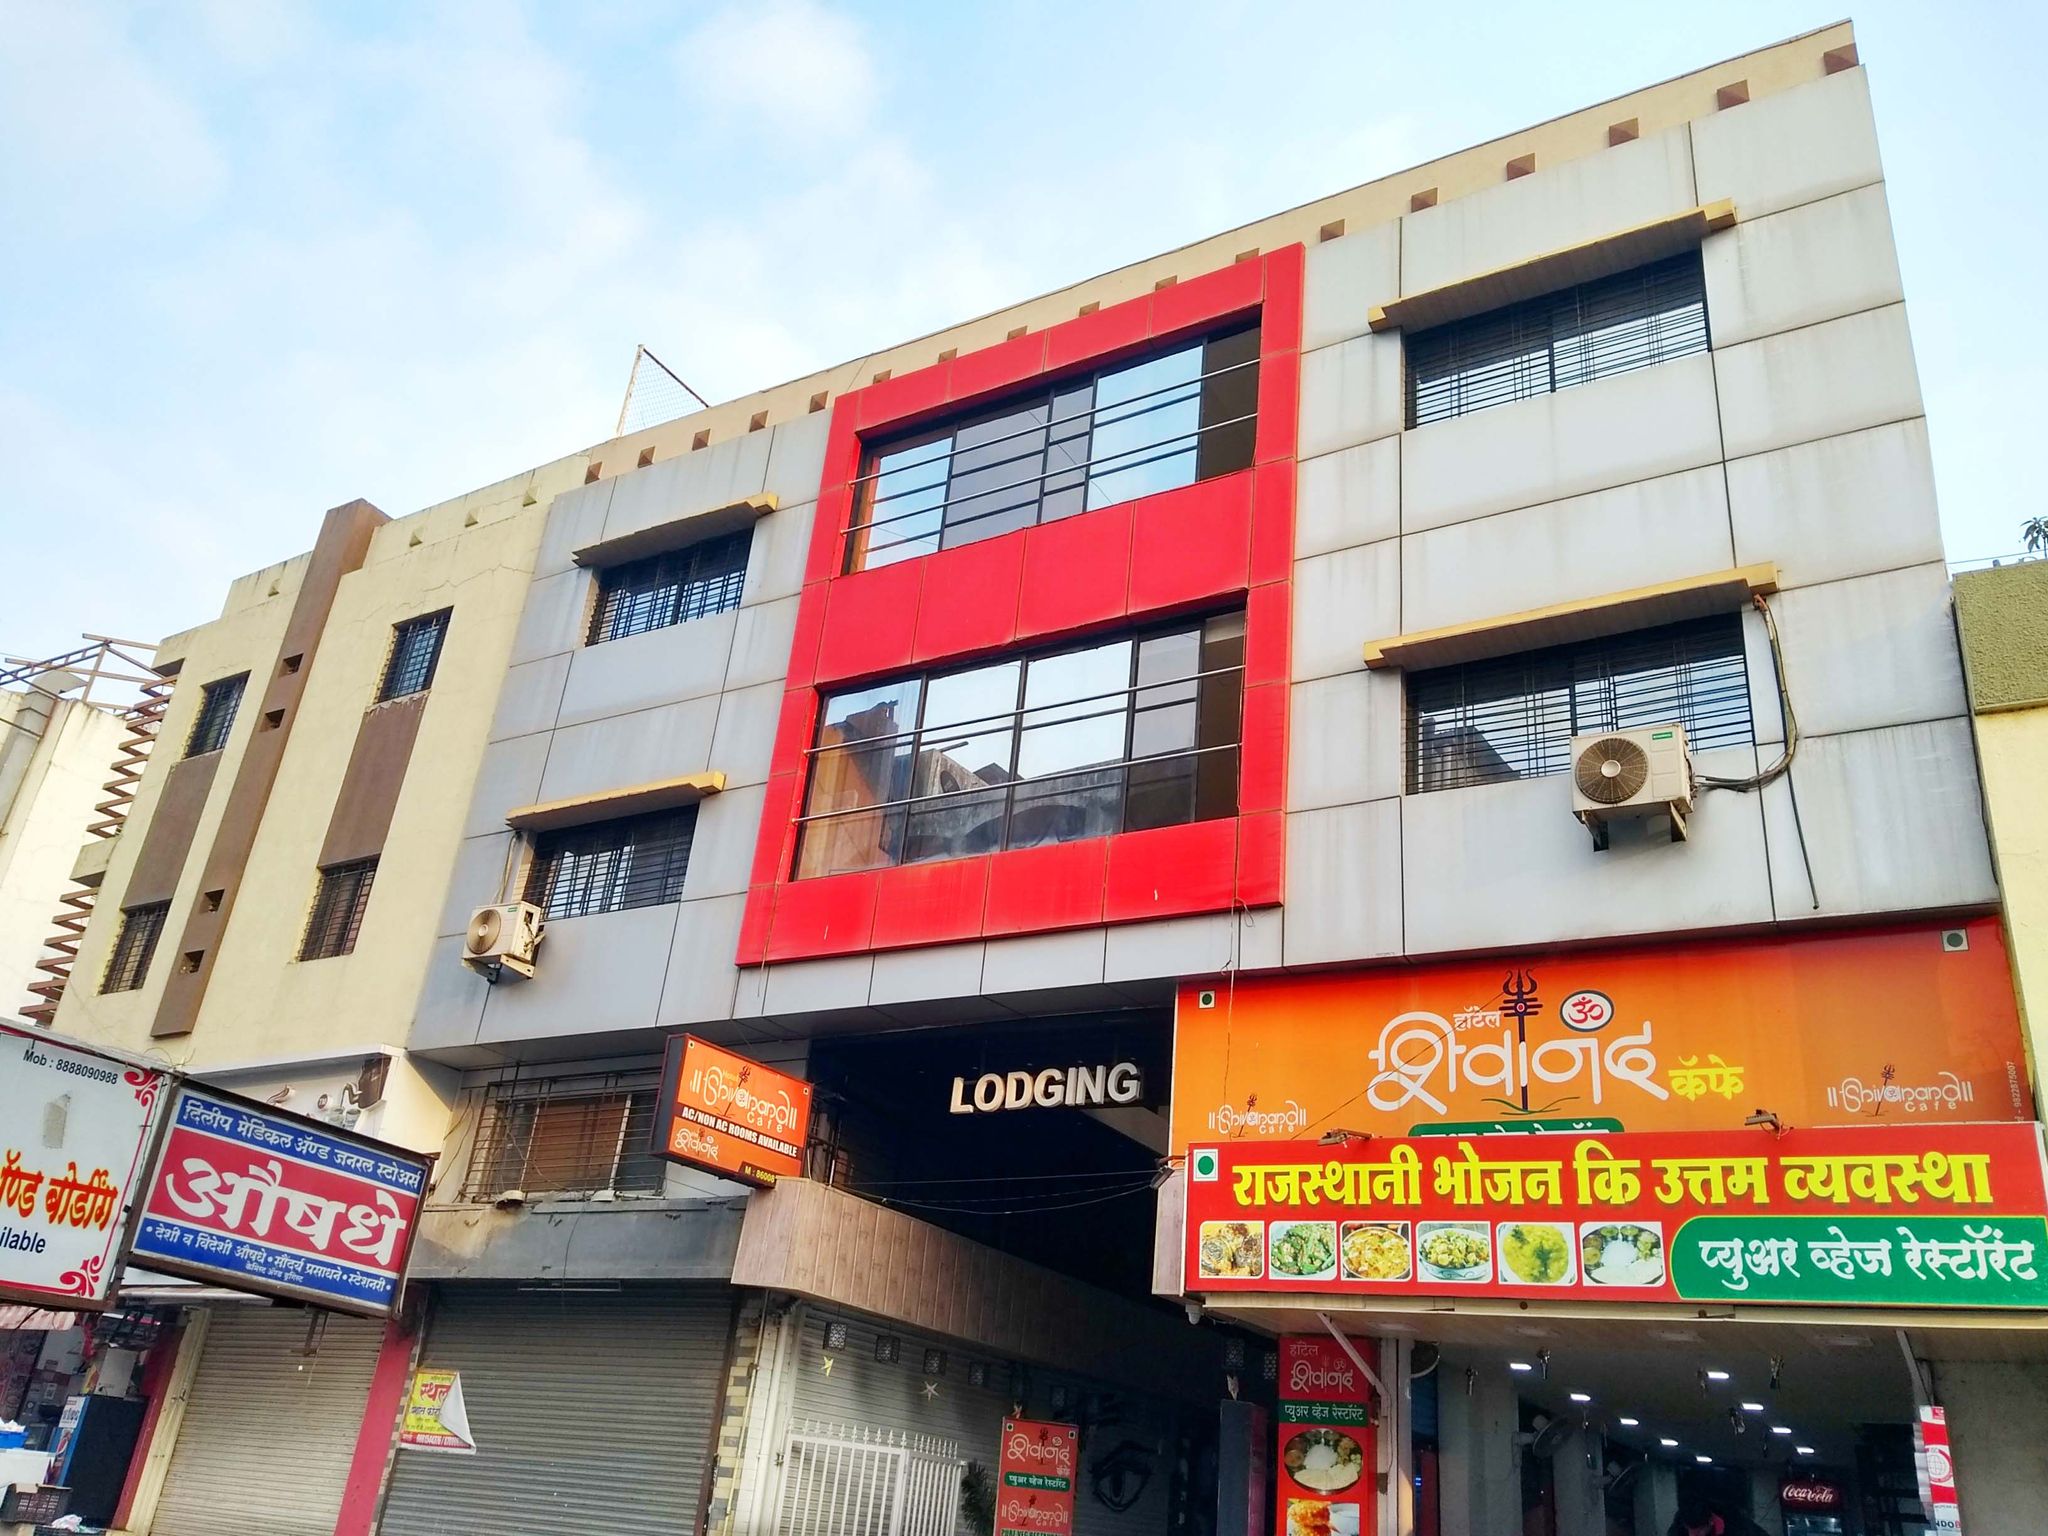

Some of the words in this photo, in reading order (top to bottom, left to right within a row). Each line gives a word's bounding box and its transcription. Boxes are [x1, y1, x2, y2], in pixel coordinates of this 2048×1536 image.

[1452, 1006, 1502, 1031] हॉटेल
[23, 1049, 47, 1066] Mob
[56, 1059, 118, 1084] 8888090988
[1668, 1054, 1745, 1103] कॅफे
[950, 1062, 1141, 1114] LODGING
[747, 1111, 783, 1133] Cafe
[1904, 1101, 1958, 1113] Cafe
[183, 1099, 233, 1132] दिलीप
[237, 1115, 294, 1148] मेडिकल
[333, 1148, 375, 1173] जनरल
[377, 1162, 422, 1189] स्टोअर्स
[682, 1106, 716, 1128] AC/NON
[715, 1120, 728, 1132] AC
[728, 1123, 758, 1143] ROOMS
[757, 1134, 798, 1158] AVAILABLE
[1259, 1124, 1295, 1135] Cafe
[744, 1166, 753, 1176] M
[1232, 1143, 1422, 1206] राजस्थानी
[1433, 1141, 1563, 1206] भोजन
[1573, 1139, 1641, 1206] कि
[1651, 1157, 1770, 1206] उत्तम
[1780, 1151, 1994, 1205] व्यवस्था
[166, 1157, 406, 1266] औषधे
[0, 1226, 46, 1254] ilable
[155, 1224, 181, 1243] देशी
[183, 1233, 195, 1247] व
[195, 1233, 234, 1255] विदेशी
[234, 1245, 268, 1264] औषधे
[274, 1253, 305, 1274] सौंदर्य
[305, 1264, 343, 1282] प्रसाधने
[348, 1272, 387, 1292] स्टेशनरी
[1698, 1237, 1802, 1291] प्युअर
[1807, 1226, 1892, 1280] व्हेज
[1896, 1225, 2039, 1282] रेस्टॉरंट
[1289, 1340, 1320, 1357] हॉटेल
[1284, 1405, 1309, 1422] प्युअर
[1311, 1403, 1329, 1419] व्हेज
[1332, 1403, 1364, 1420] रेस्टॉरंट
